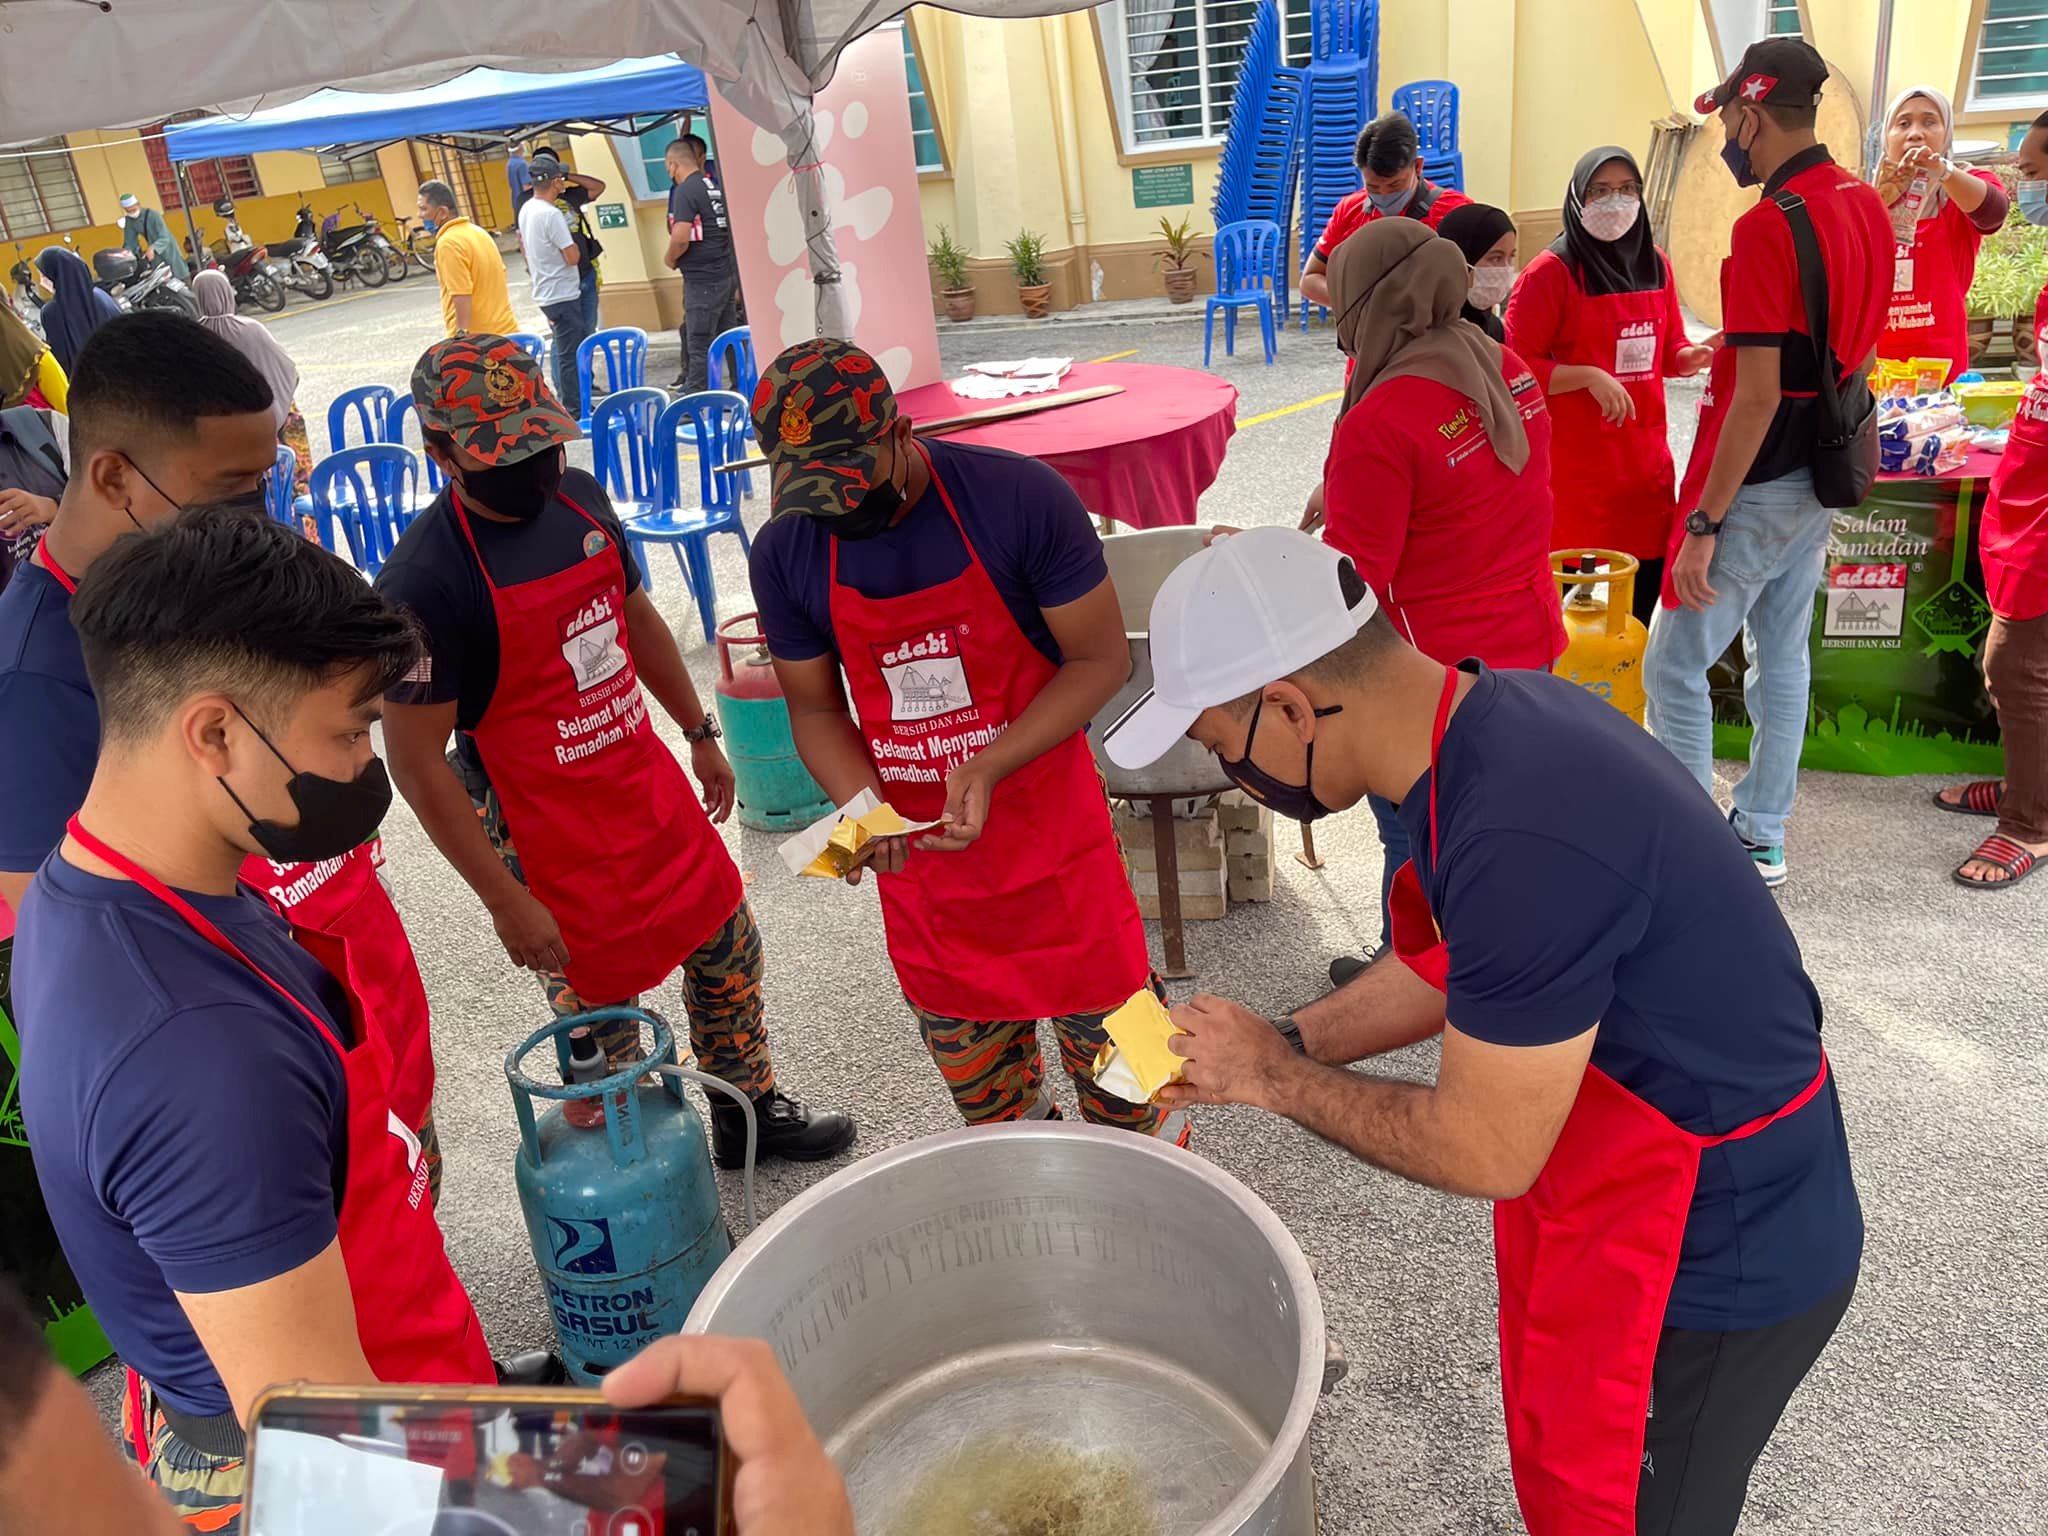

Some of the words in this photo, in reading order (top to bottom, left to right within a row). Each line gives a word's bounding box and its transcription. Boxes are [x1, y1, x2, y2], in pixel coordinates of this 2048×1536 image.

[1888, 301, 1932, 319] enyambut
[1620, 321, 1654, 337] adabi
[1834, 510, 1907, 533] Salam
[1836, 566, 1900, 585] adabi
[566, 596, 612, 637] adabi
[882, 632, 949, 665] adabi
[1821, 640, 1856, 649] BERSIH
[1857, 640, 1878, 649] DAN
[1880, 640, 1901, 649] ASLI
[579, 686, 611, 708] BERSIH
[557, 704, 613, 739] Selamat
[892, 722, 927, 737] BERSIH
[930, 715, 953, 731] DAN
[955, 709, 980, 724] ASLI
[554, 725, 624, 764] Ramadhan
[872, 738, 927, 761] Selamat
[927, 719, 1008, 759] Menyamb
[878, 763, 941, 783] amadhan
[547, 1278, 654, 1312] PETRON
[554, 1306, 660, 1336] GASUL
[613, 1339, 632, 1349] 12
